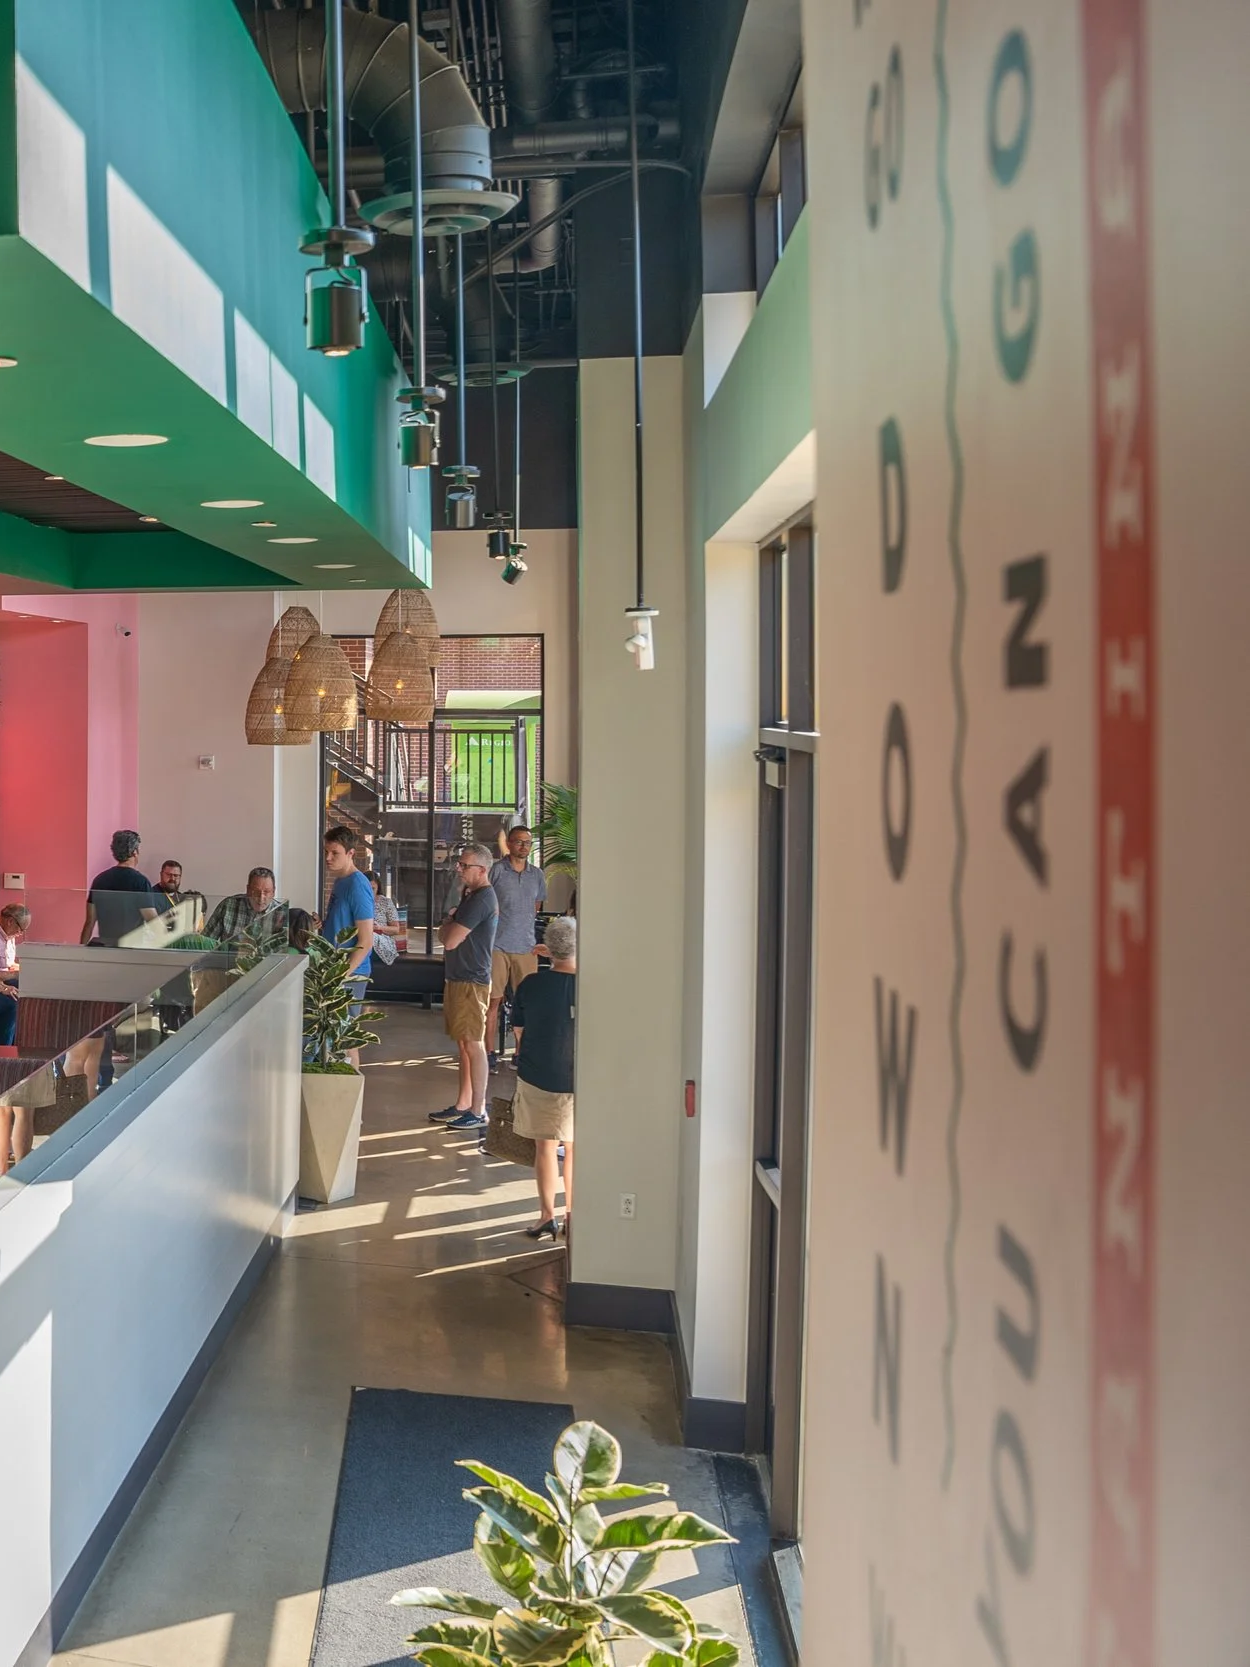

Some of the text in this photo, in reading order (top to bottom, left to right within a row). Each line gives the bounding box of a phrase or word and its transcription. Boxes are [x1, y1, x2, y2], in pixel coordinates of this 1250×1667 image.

[985, 27, 1042, 386] GO
[996, 553, 1052, 1076] CAN
[1093, 38, 1150, 1667] ANTINA
